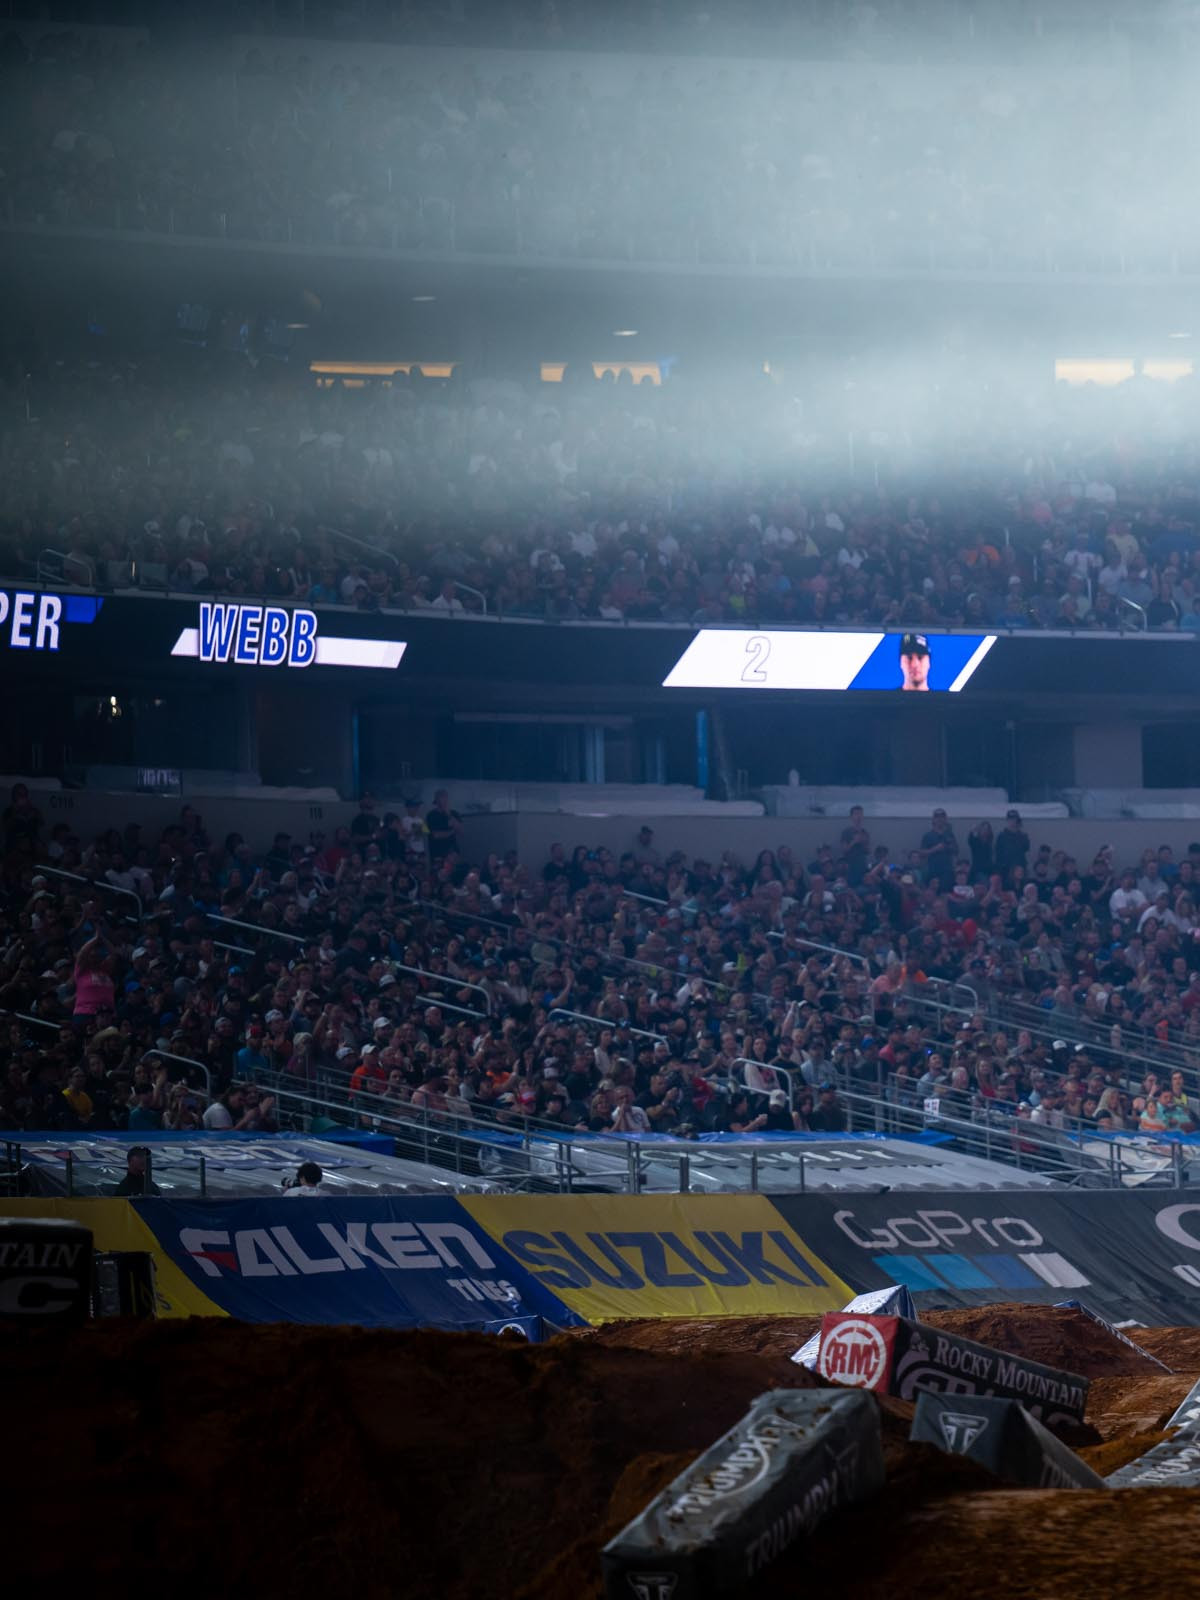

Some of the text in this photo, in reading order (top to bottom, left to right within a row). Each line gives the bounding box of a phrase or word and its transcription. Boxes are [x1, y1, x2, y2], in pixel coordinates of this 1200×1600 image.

[199, 602, 318, 667] WEBB
[740, 635, 771, 682] 2
[178, 1221, 497, 1278] FALKEN
[832, 1209, 1044, 1249] GoPro
[502, 1230, 829, 1290] SUZUKI
[831, 1343, 873, 1376] RM
[934, 1335, 993, 1380] ROCKY
[995, 1358, 1085, 1409] MOUNTAIN
